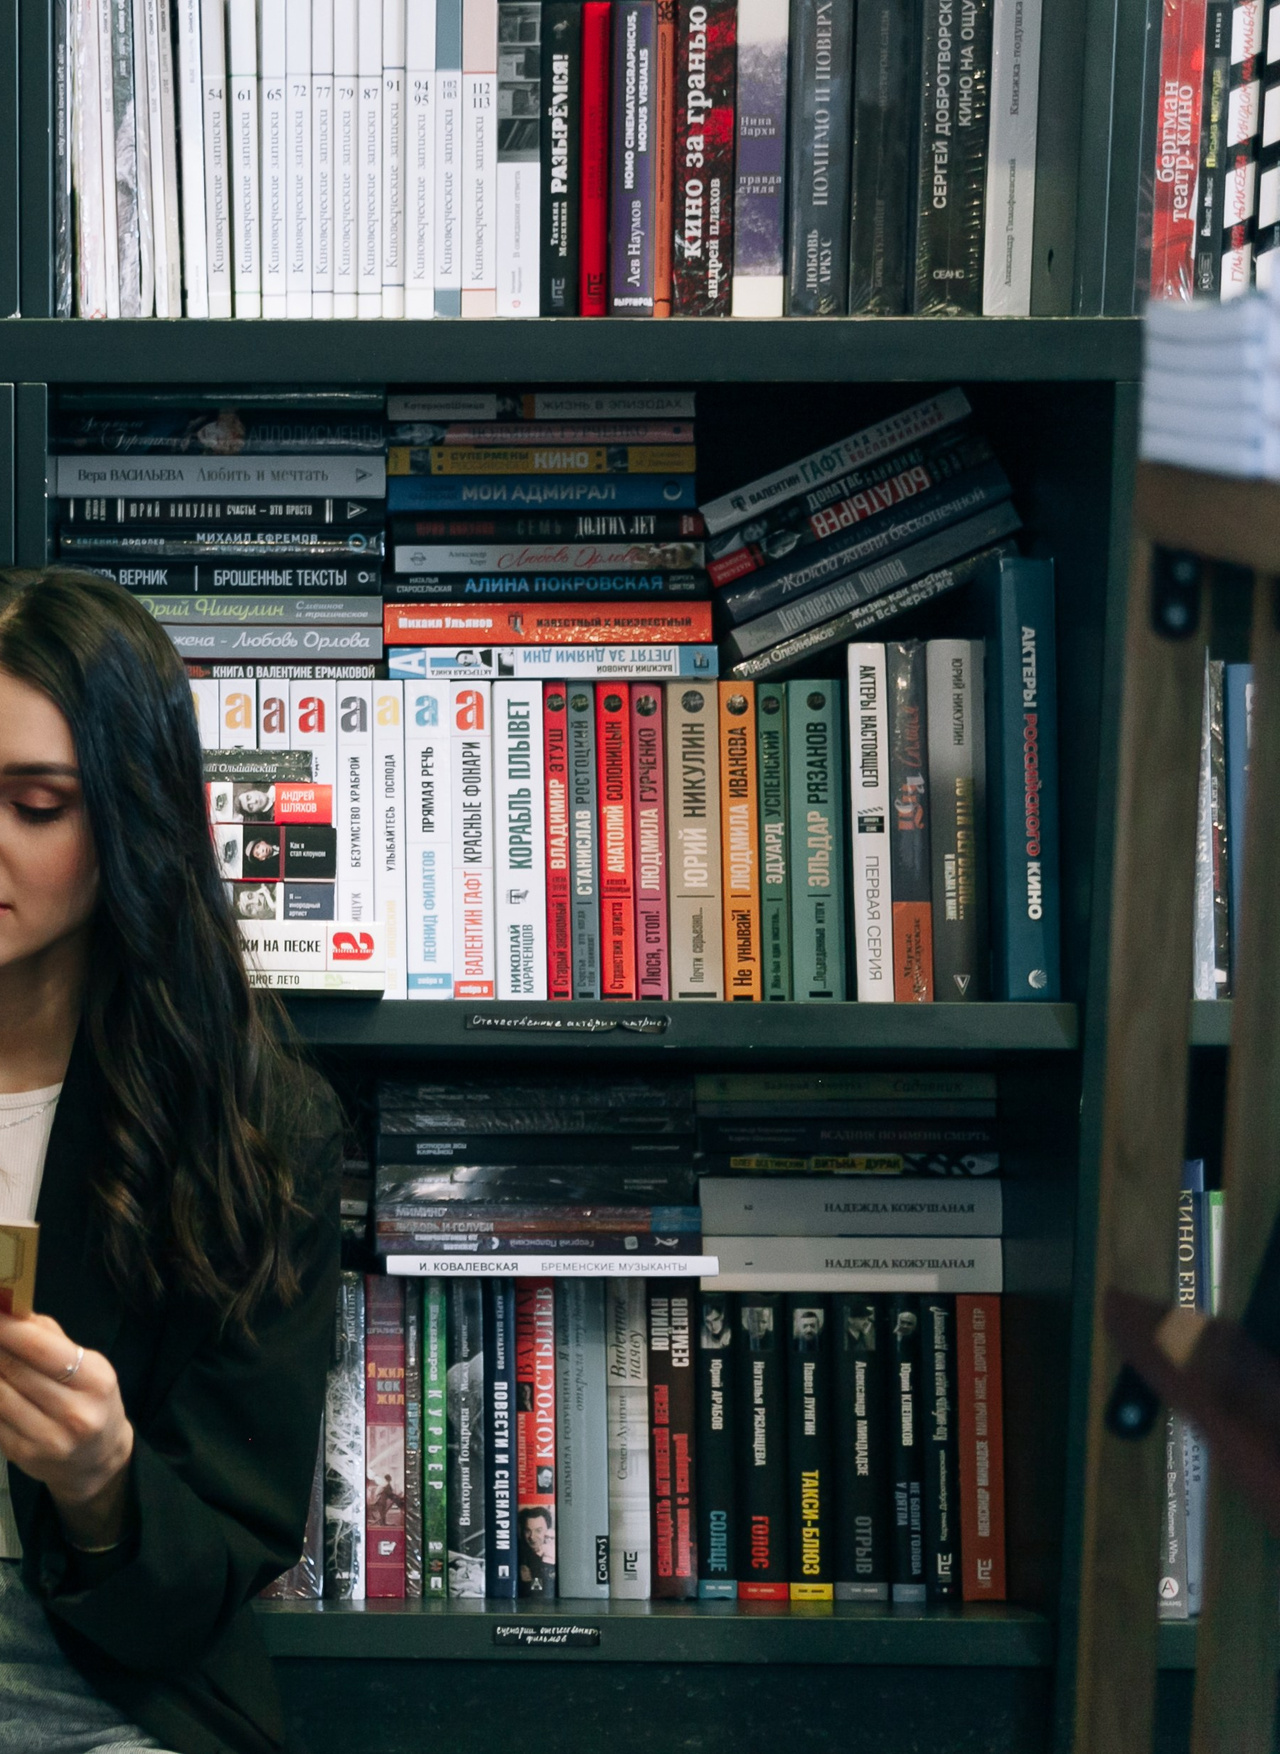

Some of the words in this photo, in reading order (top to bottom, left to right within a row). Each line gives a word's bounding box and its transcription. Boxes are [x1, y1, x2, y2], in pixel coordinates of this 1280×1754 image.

[640, 49, 649, 104] VISUALIS
[688, 6, 712, 124] гранью
[961, 46, 973, 70] НА
[1010, 2, 1022, 115] Книжка-подушка
[638, 107, 647, 151] MODUS
[959, 76, 972, 125] КИНО
[208, 111, 222, 168] записки
[238, 111, 251, 168] записки
[686, 136, 704, 167] за
[1157, 81, 1179, 182] бергман
[625, 151, 635, 189] HOMO
[933, 141, 947, 208] СЕРГЕЙ
[628, 200, 644, 256] Наумов
[628, 258, 640, 286] Лев
[78, 469, 106, 483] Вера
[110, 470, 184, 481] ВАСИЛЬЕВА
[197, 468, 250, 481] Любить
[256, 471, 265, 480] и
[271, 470, 328, 481] мечтать
[120, 569, 168, 585] ВЕРНИК
[214, 570, 292, 586] БРОШЕННЫЕ
[297, 570, 347, 586] ТЕКСТЫ
[464, 578, 529, 593] АЛИНА
[535, 576, 663, 591] ПОКРОВСКАЯ
[232, 632, 297, 649] Любовь
[303, 632, 370, 648] Орлова
[1022, 627, 1035, 707] АКТЕРЫ
[213, 666, 245, 678] КНИГА
[247, 667, 253, 677] О
[256, 667, 312, 678] ВАЛЕНТИНЕ
[315, 665, 375, 678] ЕРМАКОВОЙ
[859, 665, 877, 710] АКТЕРЫ
[421, 747, 433, 776] РЕЧЬ
[507, 699, 530, 779] ПЛЫВЕТ
[549, 728, 563, 772] ЭТУШ
[571, 720, 590, 804] РОСТОЦКИЙ
[605, 721, 624, 800] СОЛОНИЦЫН
[638, 728, 658, 803] ГУРЧЕНКО
[728, 726, 748, 798] ИВАНОВА
[806, 722, 828, 804] РЯЗАНОВ
[860, 715, 879, 788] НАСТОЯЩЕГО
[281, 791, 314, 801] АНДРЕЙ
[349, 756, 360, 802] ХРАБРОЙ
[384, 754, 395, 798] ГОСПОДА
[461, 741, 480, 797] ФОНАРИ
[682, 723, 706, 818] НИКУЛИН
[760, 730, 780, 817] УСПЕНСКИЙ
[1024, 714, 1041, 856] РОССИЙСКОГО
[281, 802, 317, 813] ШЛЯХОВ
[422, 781, 434, 833] ПРЯМАЯ
[463, 802, 481, 863] КРАСНЫЕ
[508, 787, 532, 870] КОРАБЛЬ
[550, 779, 568, 869] ВЛАДИМИР
[351, 807, 360, 867] БЕЗУМСТВО
[385, 806, 396, 871] УЛЫБАЙТЕСЬ
[576, 810, 593, 895] СТАНИСЛАВ
[604, 805, 625, 872] АНАТОЛИЙ
[640, 808, 662, 890] ЛЮДМИЛА
[679, 827, 708, 888] ЮРИЙ
[731, 804, 752, 890] ЛЮДМИЛА
[765, 822, 785, 884] ЭДУАРД
[808, 811, 831, 886] ЭЛЬДАР
[422, 851, 436, 910] ФИЛАТОВ
[463, 871, 481, 905] ГАФТ
[865, 855, 881, 922] ПЕРВАЯ
[1027, 862, 1042, 919] КИНО
[263, 940, 279, 951] НА
[284, 939, 321, 952] ПЕСКЕ
[423, 914, 437, 963] ЛЕОНИД
[464, 909, 484, 975] ВАЛЕНТИН
[508, 924, 521, 994] НИКОЛАЙ
[522, 924, 534, 994] КАРАЧЕНЦОВ
[867, 926, 882, 981] СЕРИЯ
[277, 975, 299, 984] ЛЕТО
[734, 969, 753, 987] Не
[433, 1262, 519, 1272] КОВАЛЕВСКАЯ
[540, 1262, 615, 1272] БРЕМЕНСКИЕ
[618, 1262, 688, 1272] МУЗЫКАНТЫ
[493, 1382, 508, 1450] ПОВЕСТИ
[495, 1454, 508, 1463] И
[1167, 1472, 1176, 1497] Black
[493, 1470, 510, 1550] СЦЕНАРИИ
[801, 1470, 819, 1575] ТАКСИ-БЛЮЗ
[1167, 1500, 1177, 1538] Women
[708, 1510, 726, 1571] СОЛНЦЕ
[752, 1515, 768, 1568] ГОЛОС
[1168, 1540, 1177, 1563] Who
